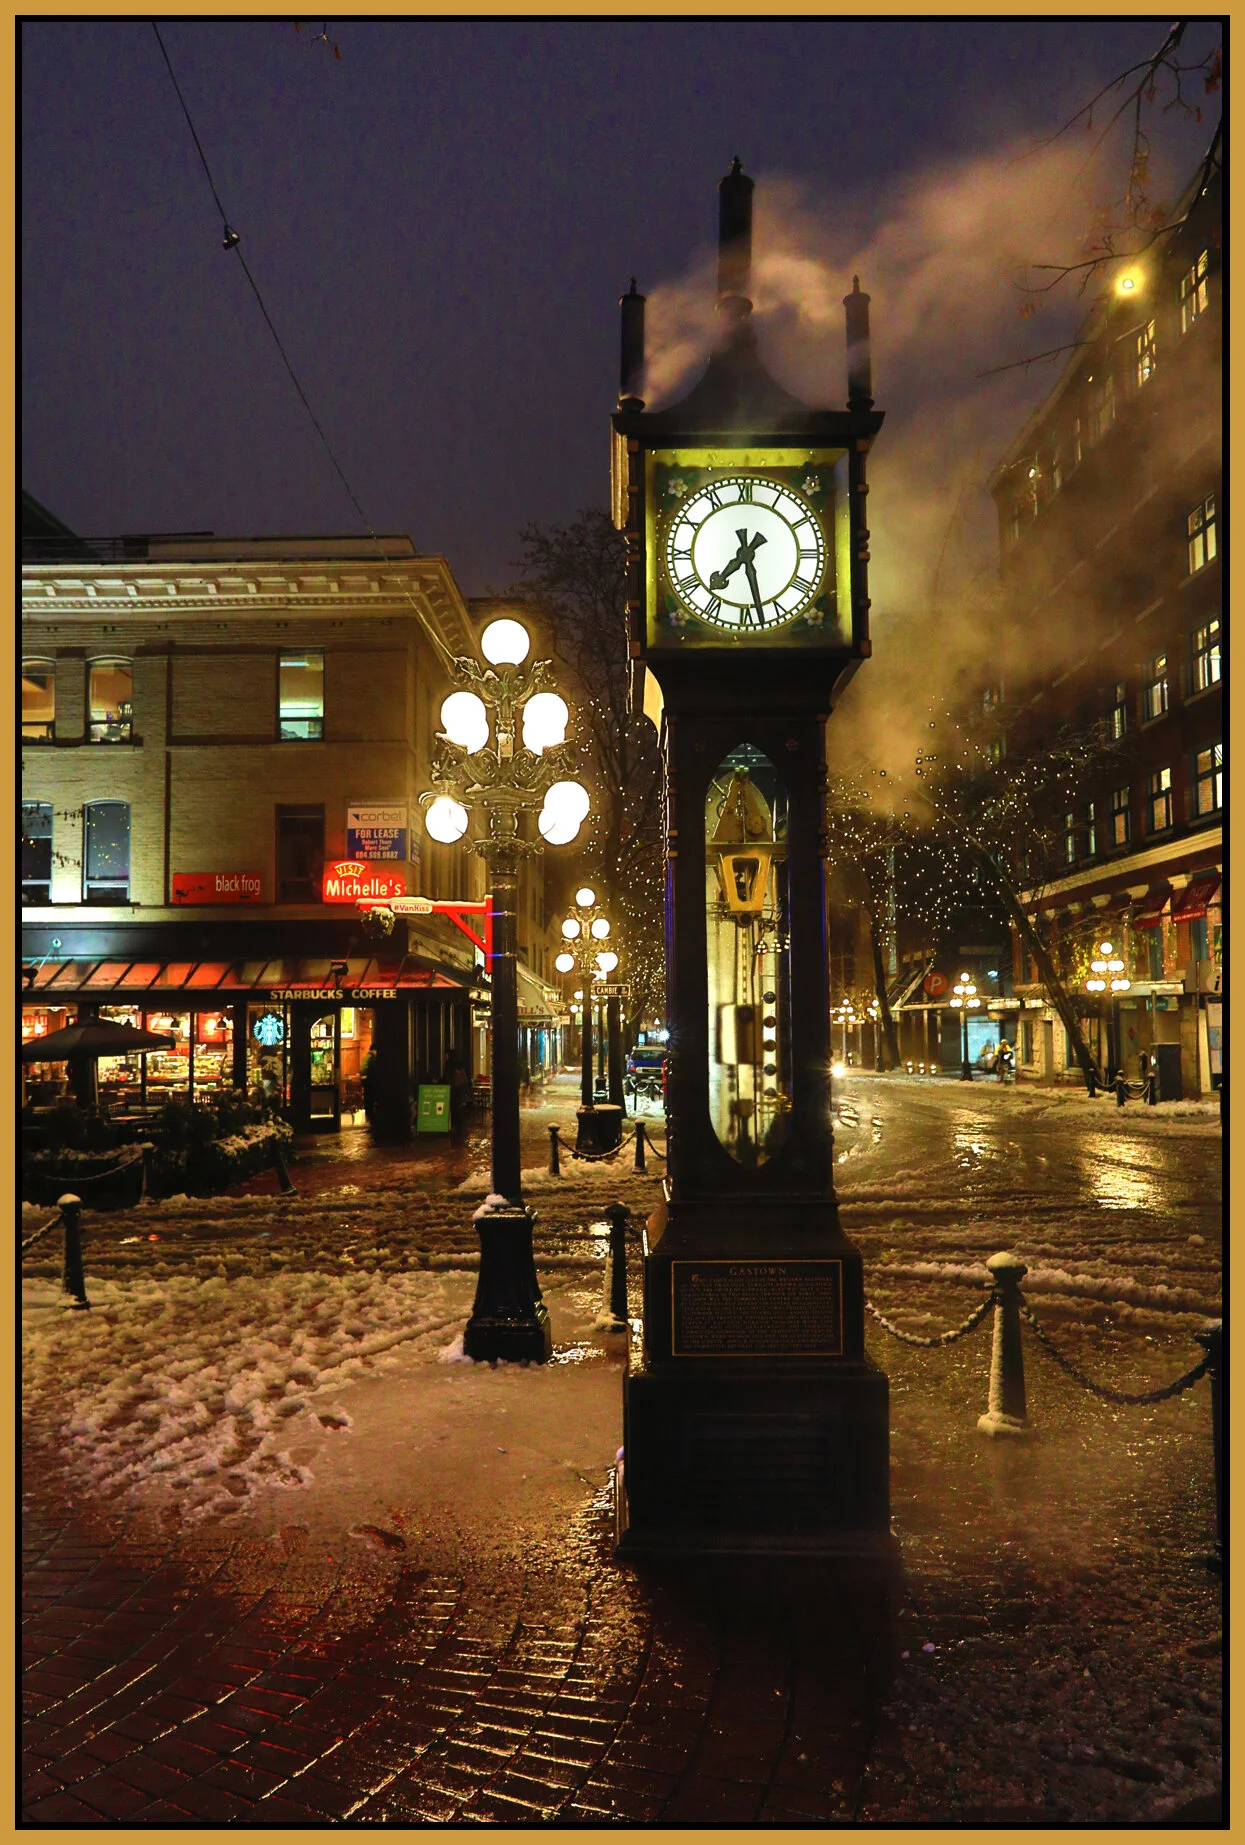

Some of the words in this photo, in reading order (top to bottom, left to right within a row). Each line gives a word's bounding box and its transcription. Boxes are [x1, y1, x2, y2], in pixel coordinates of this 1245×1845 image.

[738, 485, 753, 502] XII
[681, 515, 700, 531] X
[361, 811, 402, 821] corbel
[355, 829, 372, 839] FOR
[373, 829, 399, 839] LEASE
[336, 865, 364, 875] VISIT
[216, 875, 240, 891] black
[241, 875, 260, 895] frog
[394, 904, 430, 912] #VanKiss
[930, 977, 942, 991] P
[270, 989, 344, 999] STARBUCKS
[351, 988, 397, 999] COFFEE
[596, 986, 618, 995] CAMBIE
[729, 1267, 787, 1276] GASTOWN
